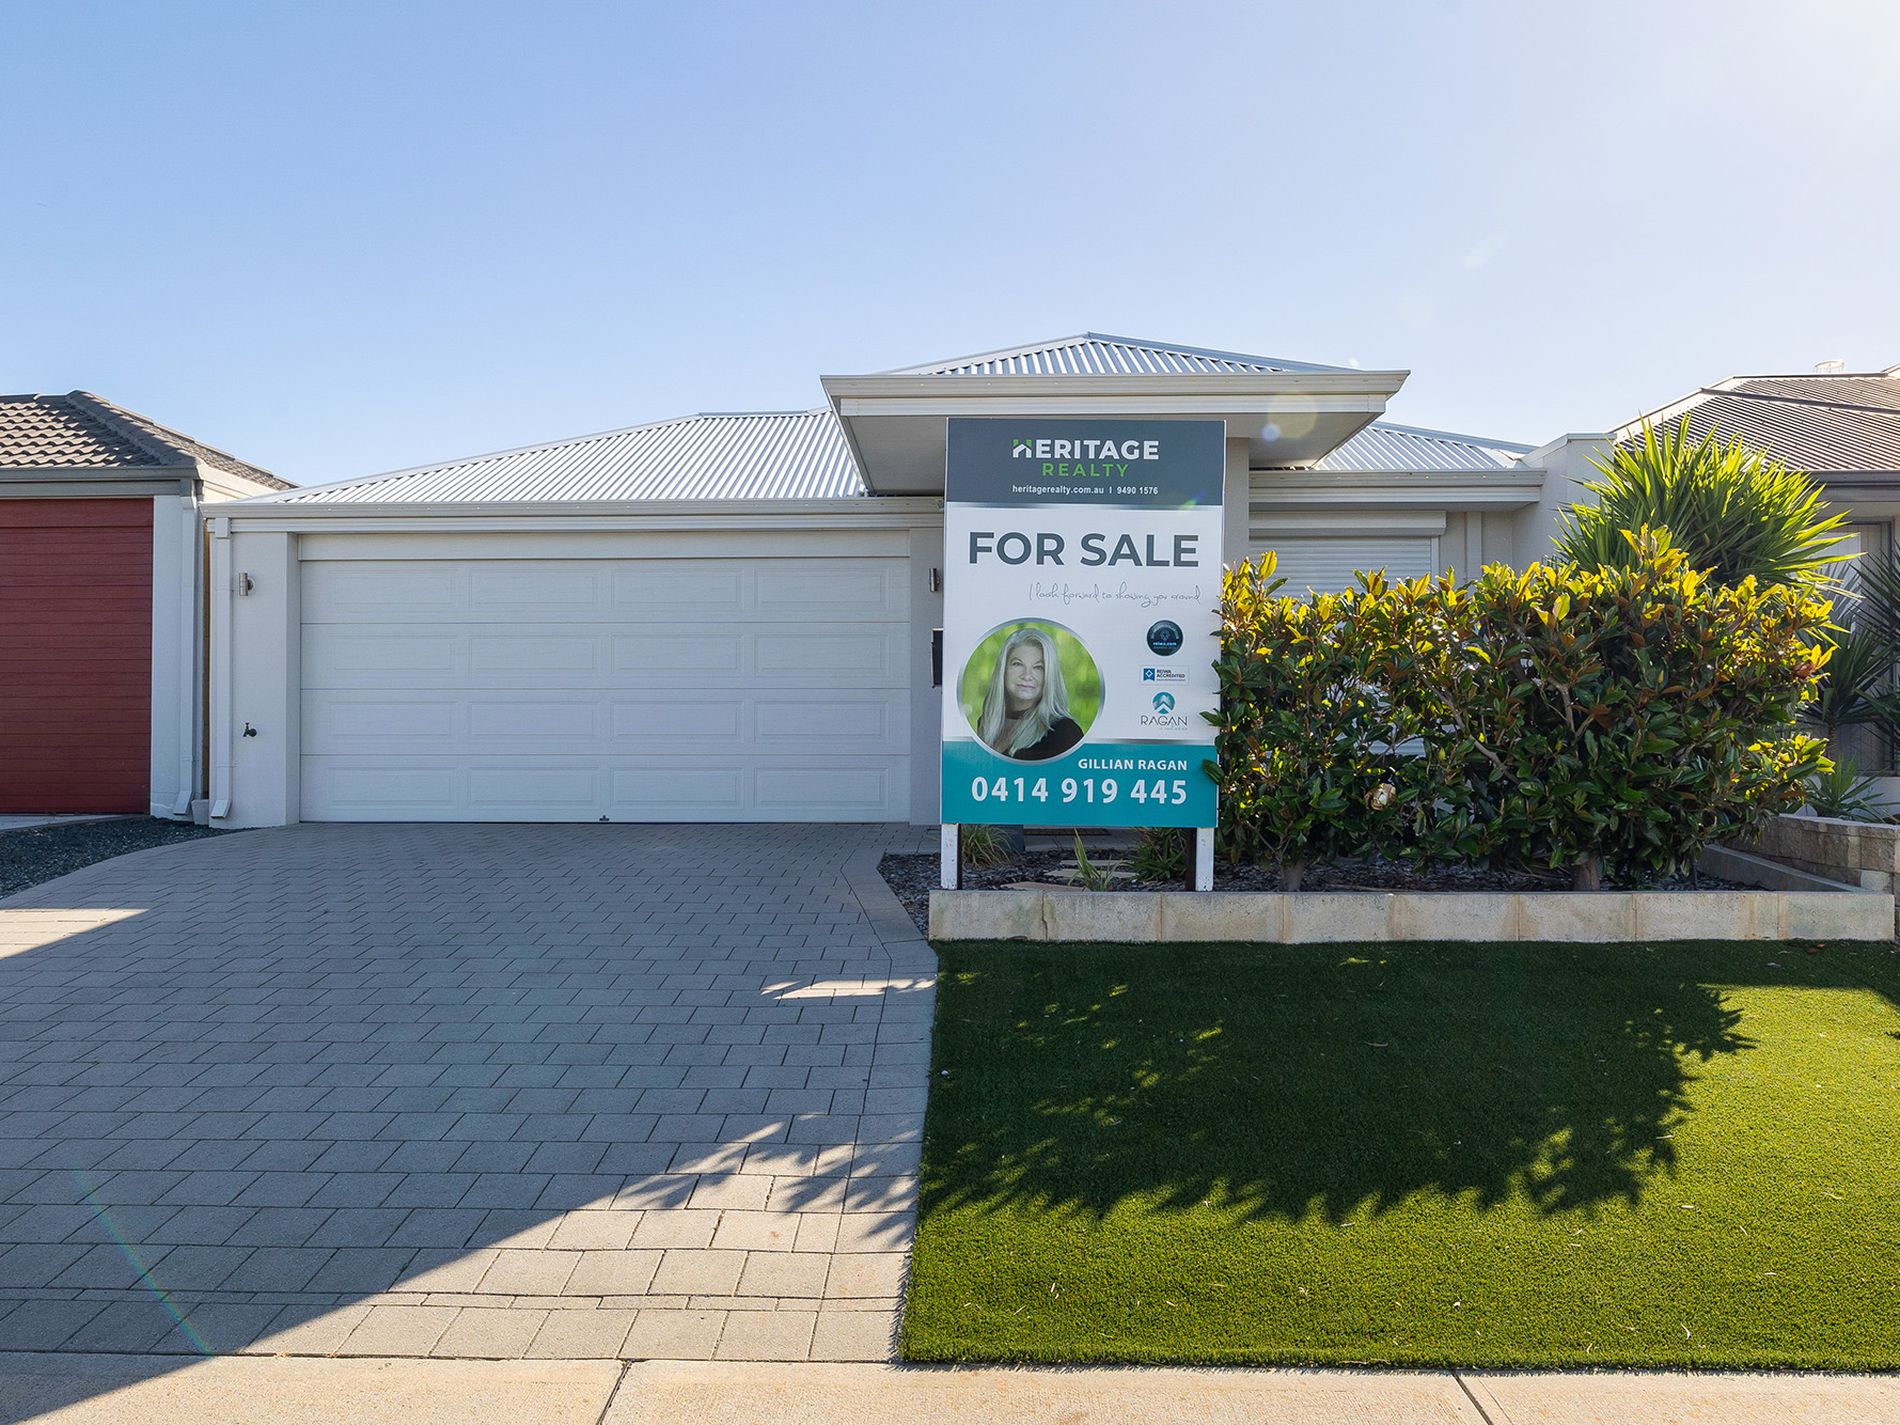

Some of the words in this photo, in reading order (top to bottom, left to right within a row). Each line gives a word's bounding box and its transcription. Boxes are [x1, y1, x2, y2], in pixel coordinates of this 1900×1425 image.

[1012, 439, 1160, 460] HERITAGE
[1042, 463, 1129, 477] REALTY
[1012, 485, 1104, 495] heritagerealty.com.au
[1117, 486, 1137, 495] 9490
[1139, 486, 1159, 495] 1576
[969, 532, 1065, 566] FOR
[1080, 533, 1199, 567] SALE
[1036, 582, 1059, 599] look
[1059, 583, 1100, 605] forward
[1102, 591, 1112, 599] to
[1115, 581, 1151, 608] showing
[1150, 593, 1168, 606] you
[1170, 585, 1201, 604] around
[1140, 715, 1188, 726] RAGAN
[1078, 759, 1134, 770] GILLIAN
[1138, 760, 1188, 771] RAGAN
[971, 777, 1049, 802] 0414
[1061, 778, 1118, 804] 919
[1130, 779, 1187, 805] 445
